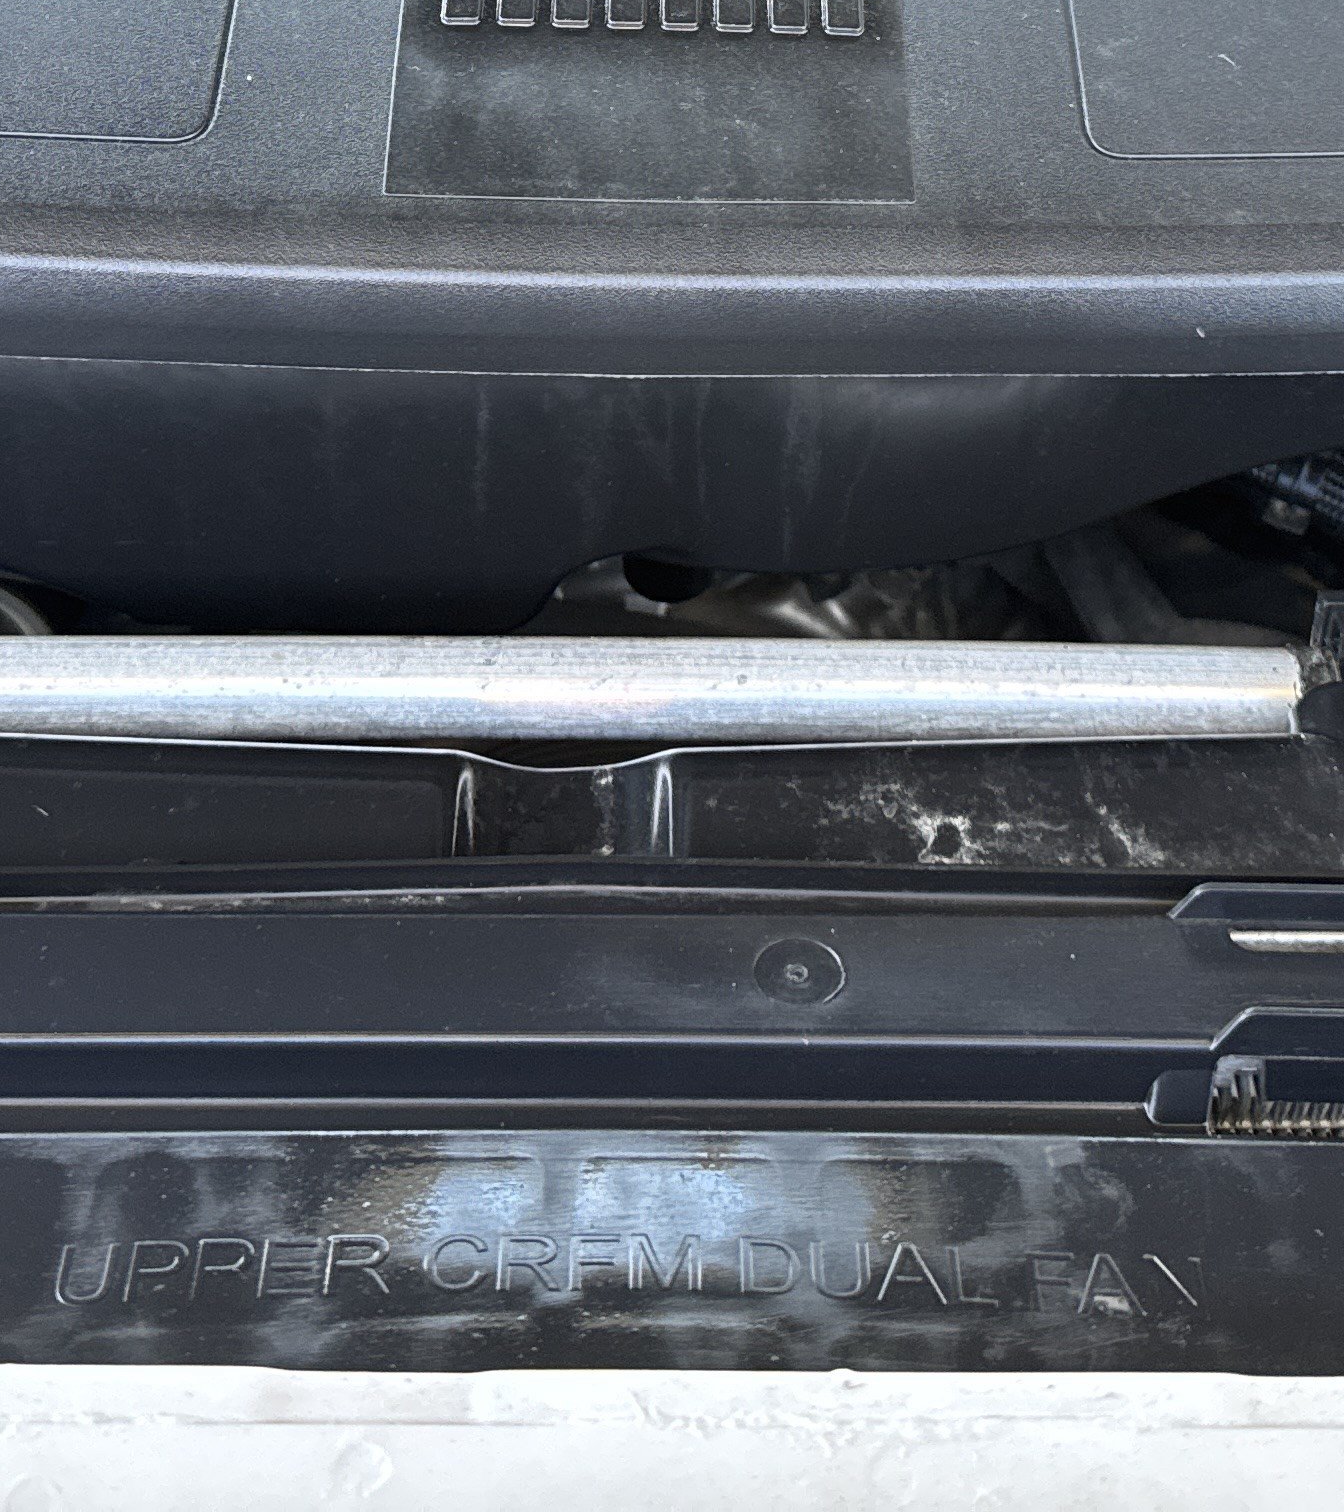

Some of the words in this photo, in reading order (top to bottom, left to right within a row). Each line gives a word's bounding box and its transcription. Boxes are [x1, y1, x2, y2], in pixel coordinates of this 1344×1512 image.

[54, 1232, 392, 1307] UPPER
[422, 1232, 702, 1292] CRFM
[739, 1234, 999, 1308] DUAL
[1024, 1248, 1206, 1318] FAN
